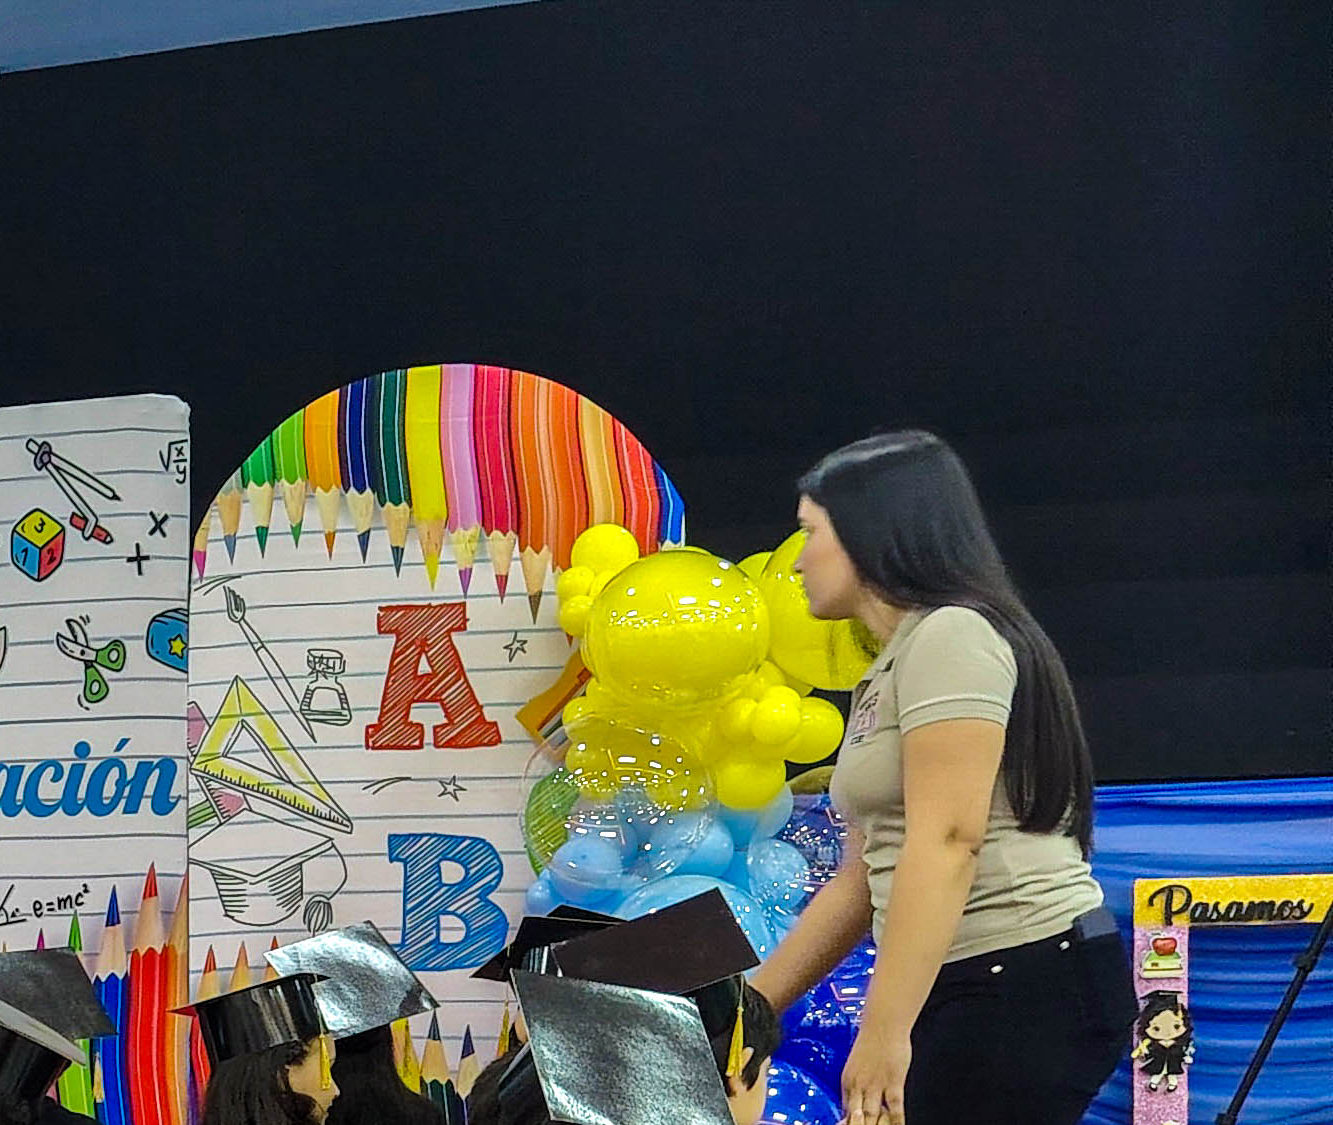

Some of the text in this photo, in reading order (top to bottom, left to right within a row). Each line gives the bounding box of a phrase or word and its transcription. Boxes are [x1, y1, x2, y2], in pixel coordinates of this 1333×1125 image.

[365, 602, 502, 750] A
[386, 833, 508, 973] B
[1148, 884, 1315, 926] Pasamos
